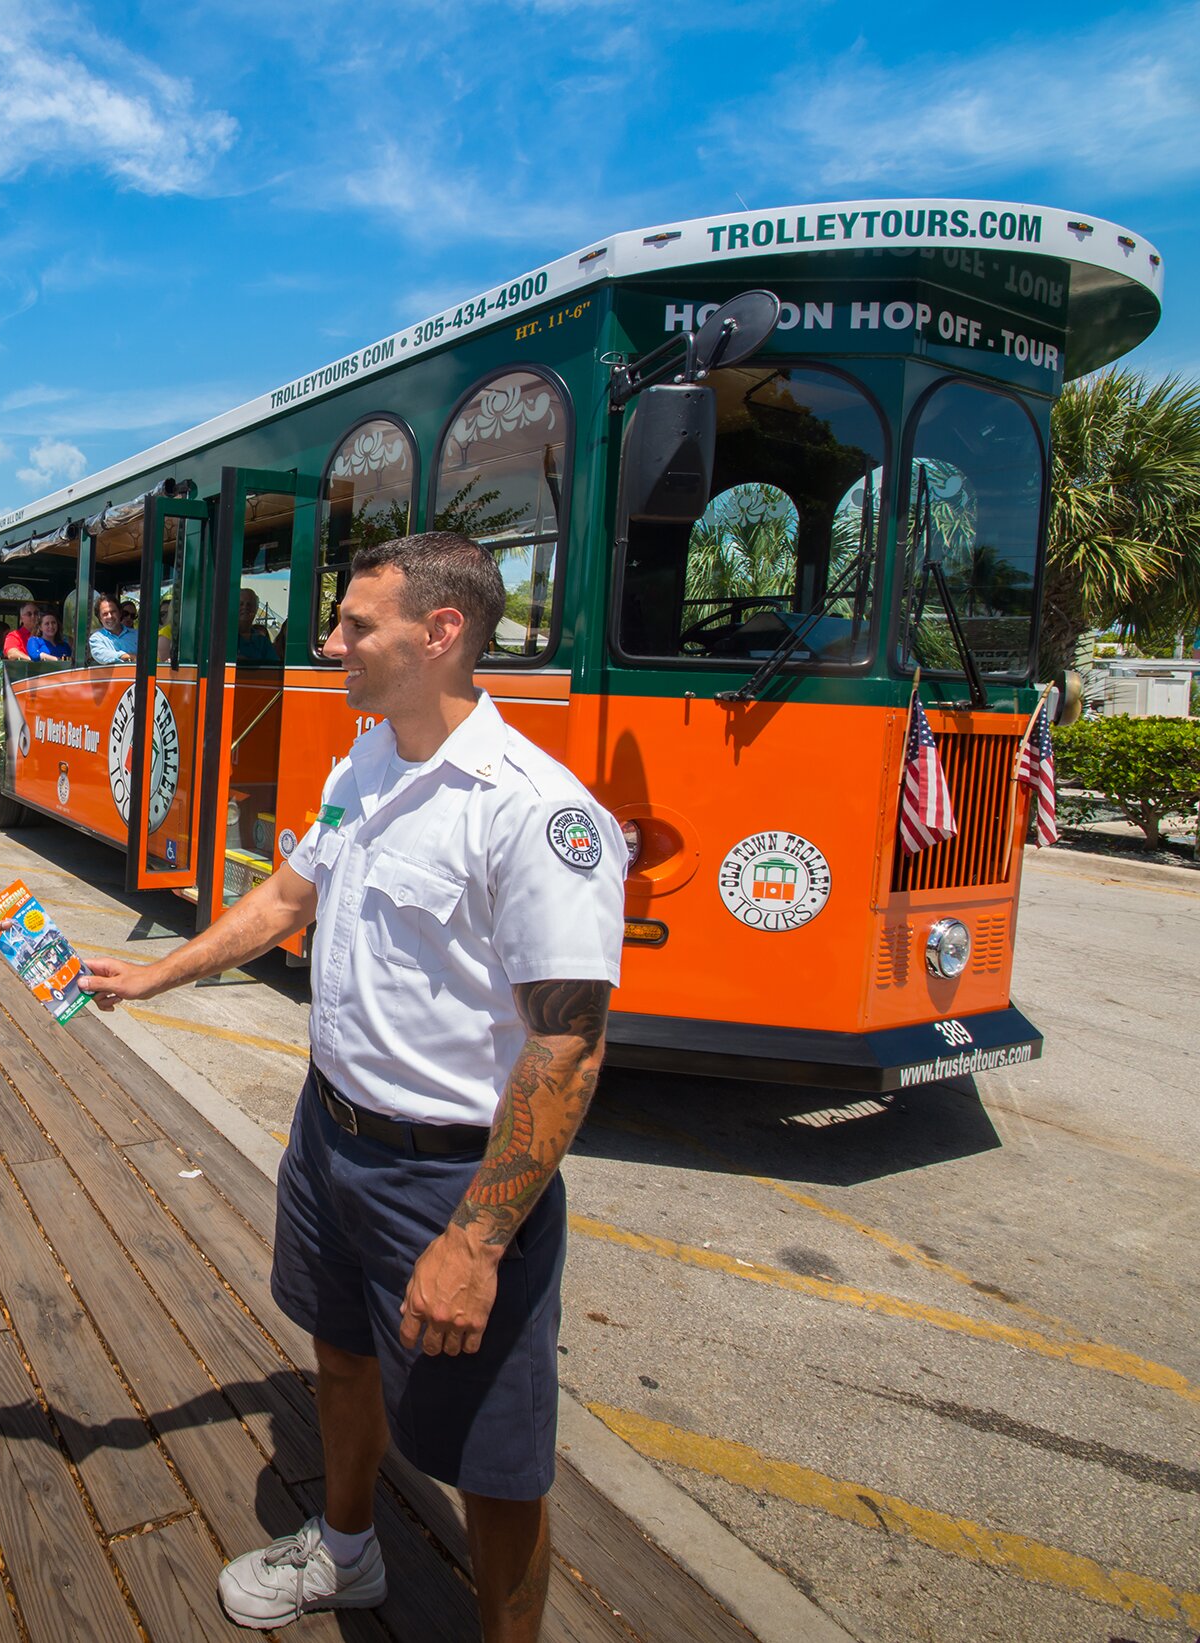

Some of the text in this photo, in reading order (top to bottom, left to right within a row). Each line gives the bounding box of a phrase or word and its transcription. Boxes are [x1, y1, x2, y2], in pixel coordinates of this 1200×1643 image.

[707, 210, 1042, 253] TROLLEYTOURS.COM
[413, 271, 548, 348] 305-434-4900
[515, 322, 543, 341] HT.
[664, 303, 722, 332] HO
[850, 302, 931, 331] HOP
[938, 316, 981, 348] OFF
[1001, 331, 1058, 371] TOUR
[84, 724, 99, 753] Tour
[112, 698, 177, 811] OLD TROLLEY
[553, 828, 564, 845] OLD
[554, 813, 575, 829] TOWN
[565, 846, 599, 863] TOURS
[720, 833, 829, 896] OLD TOWN TROLLEY
[723, 896, 813, 930] TOURS
[934, 1019, 973, 1047] 389
[900, 1044, 1032, 1087] www.trustedtours.com
